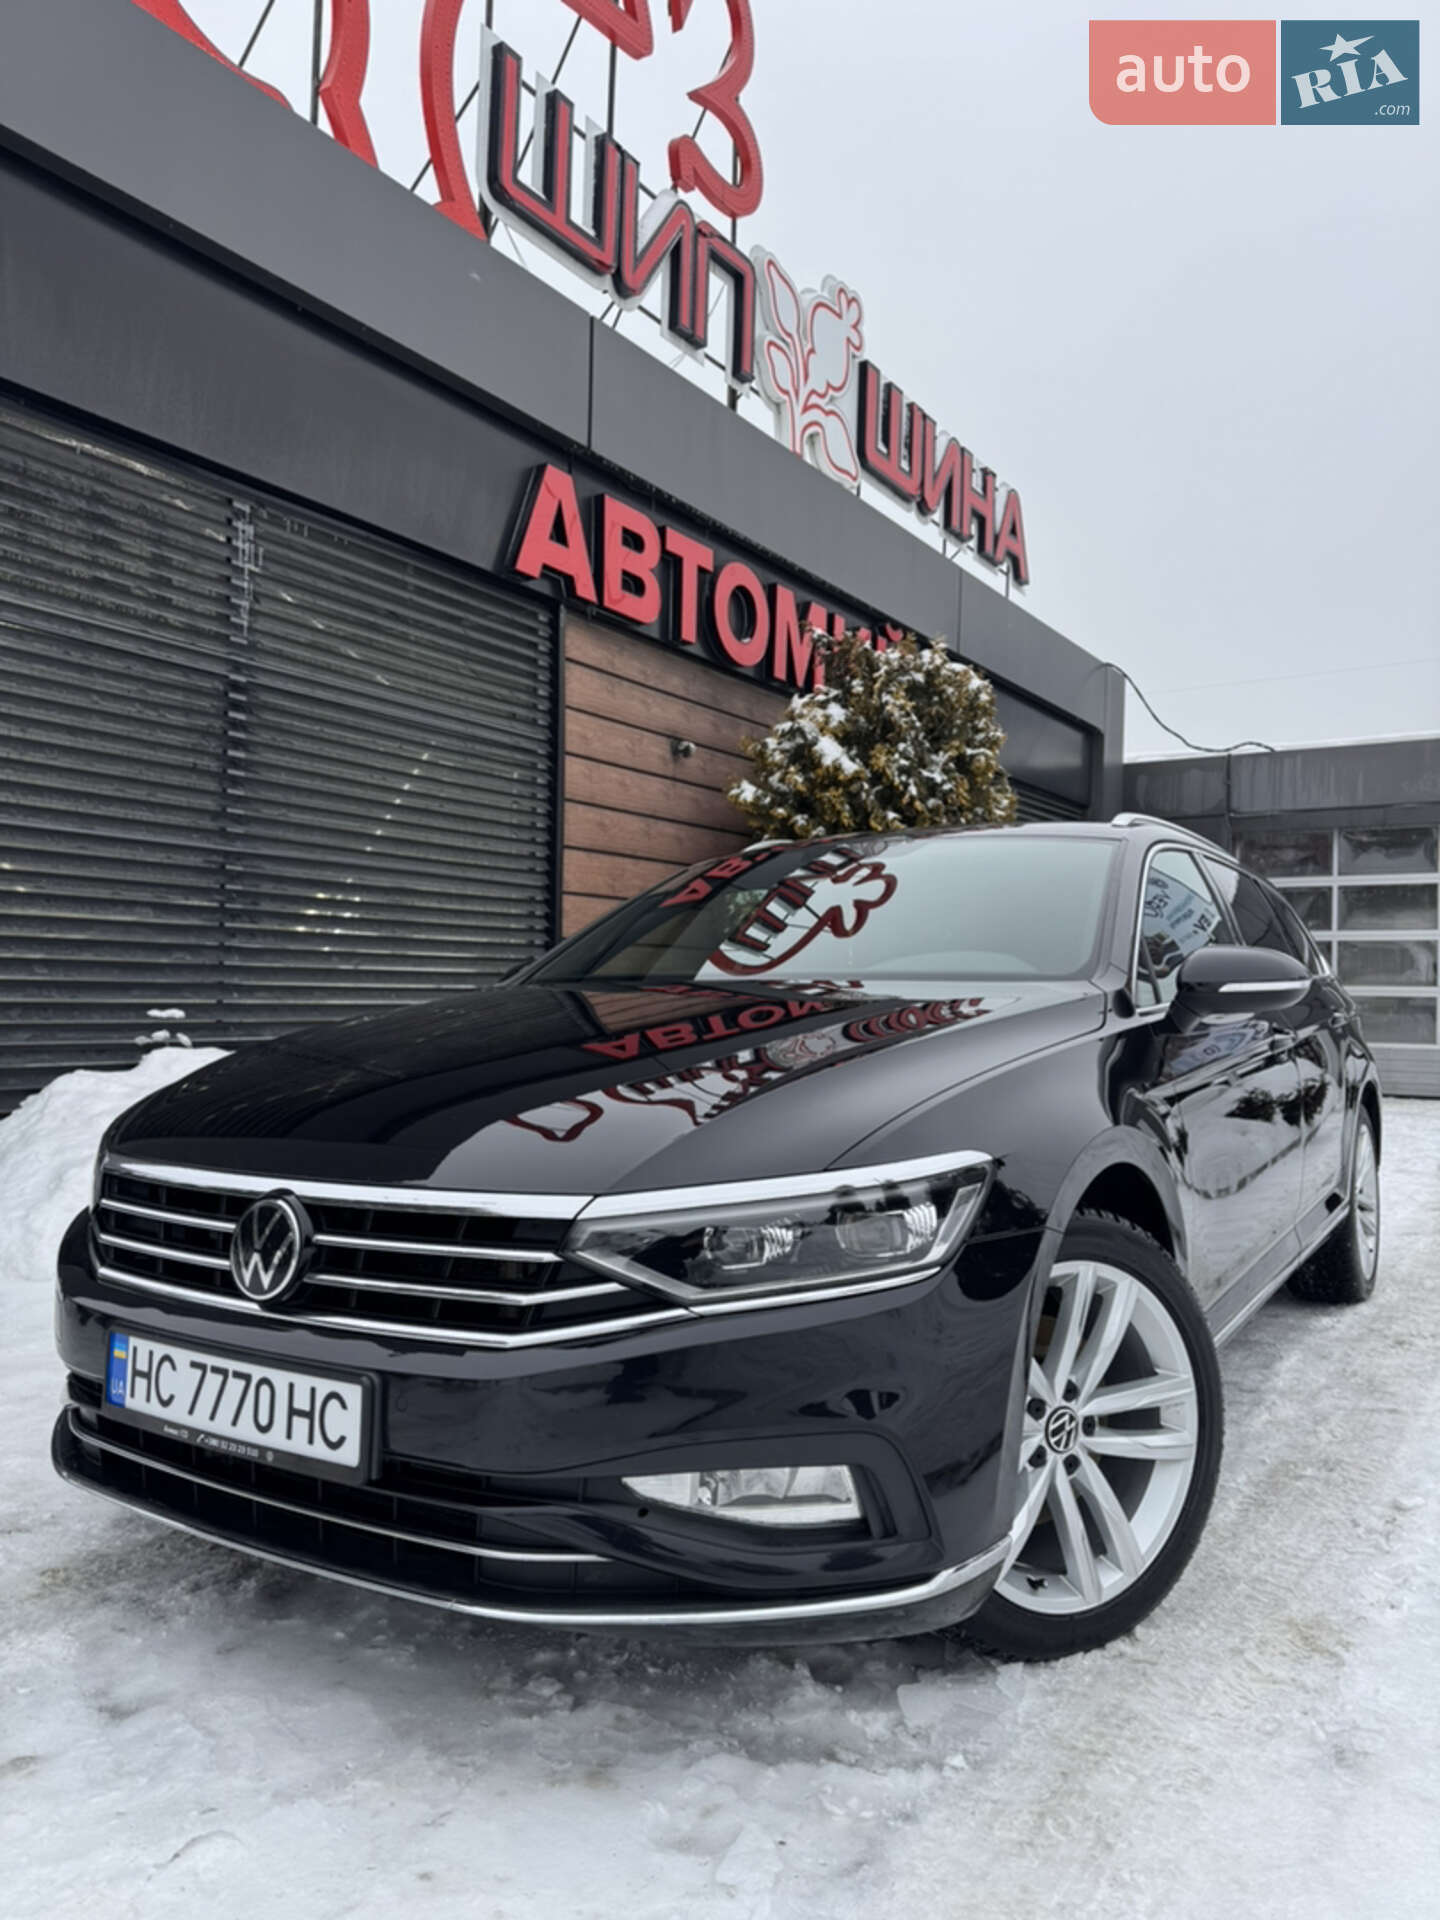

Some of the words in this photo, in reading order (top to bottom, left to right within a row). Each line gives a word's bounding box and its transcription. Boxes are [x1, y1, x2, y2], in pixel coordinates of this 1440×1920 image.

[857, 360, 1029, 585] ШИНА
[515, 463, 903, 692] АВТОМ
[110, 1377, 125, 1395] UA
[130, 1346, 177, 1408] HC
[187, 1360, 276, 1434] 7770
[286, 1381, 348, 1451] HC
